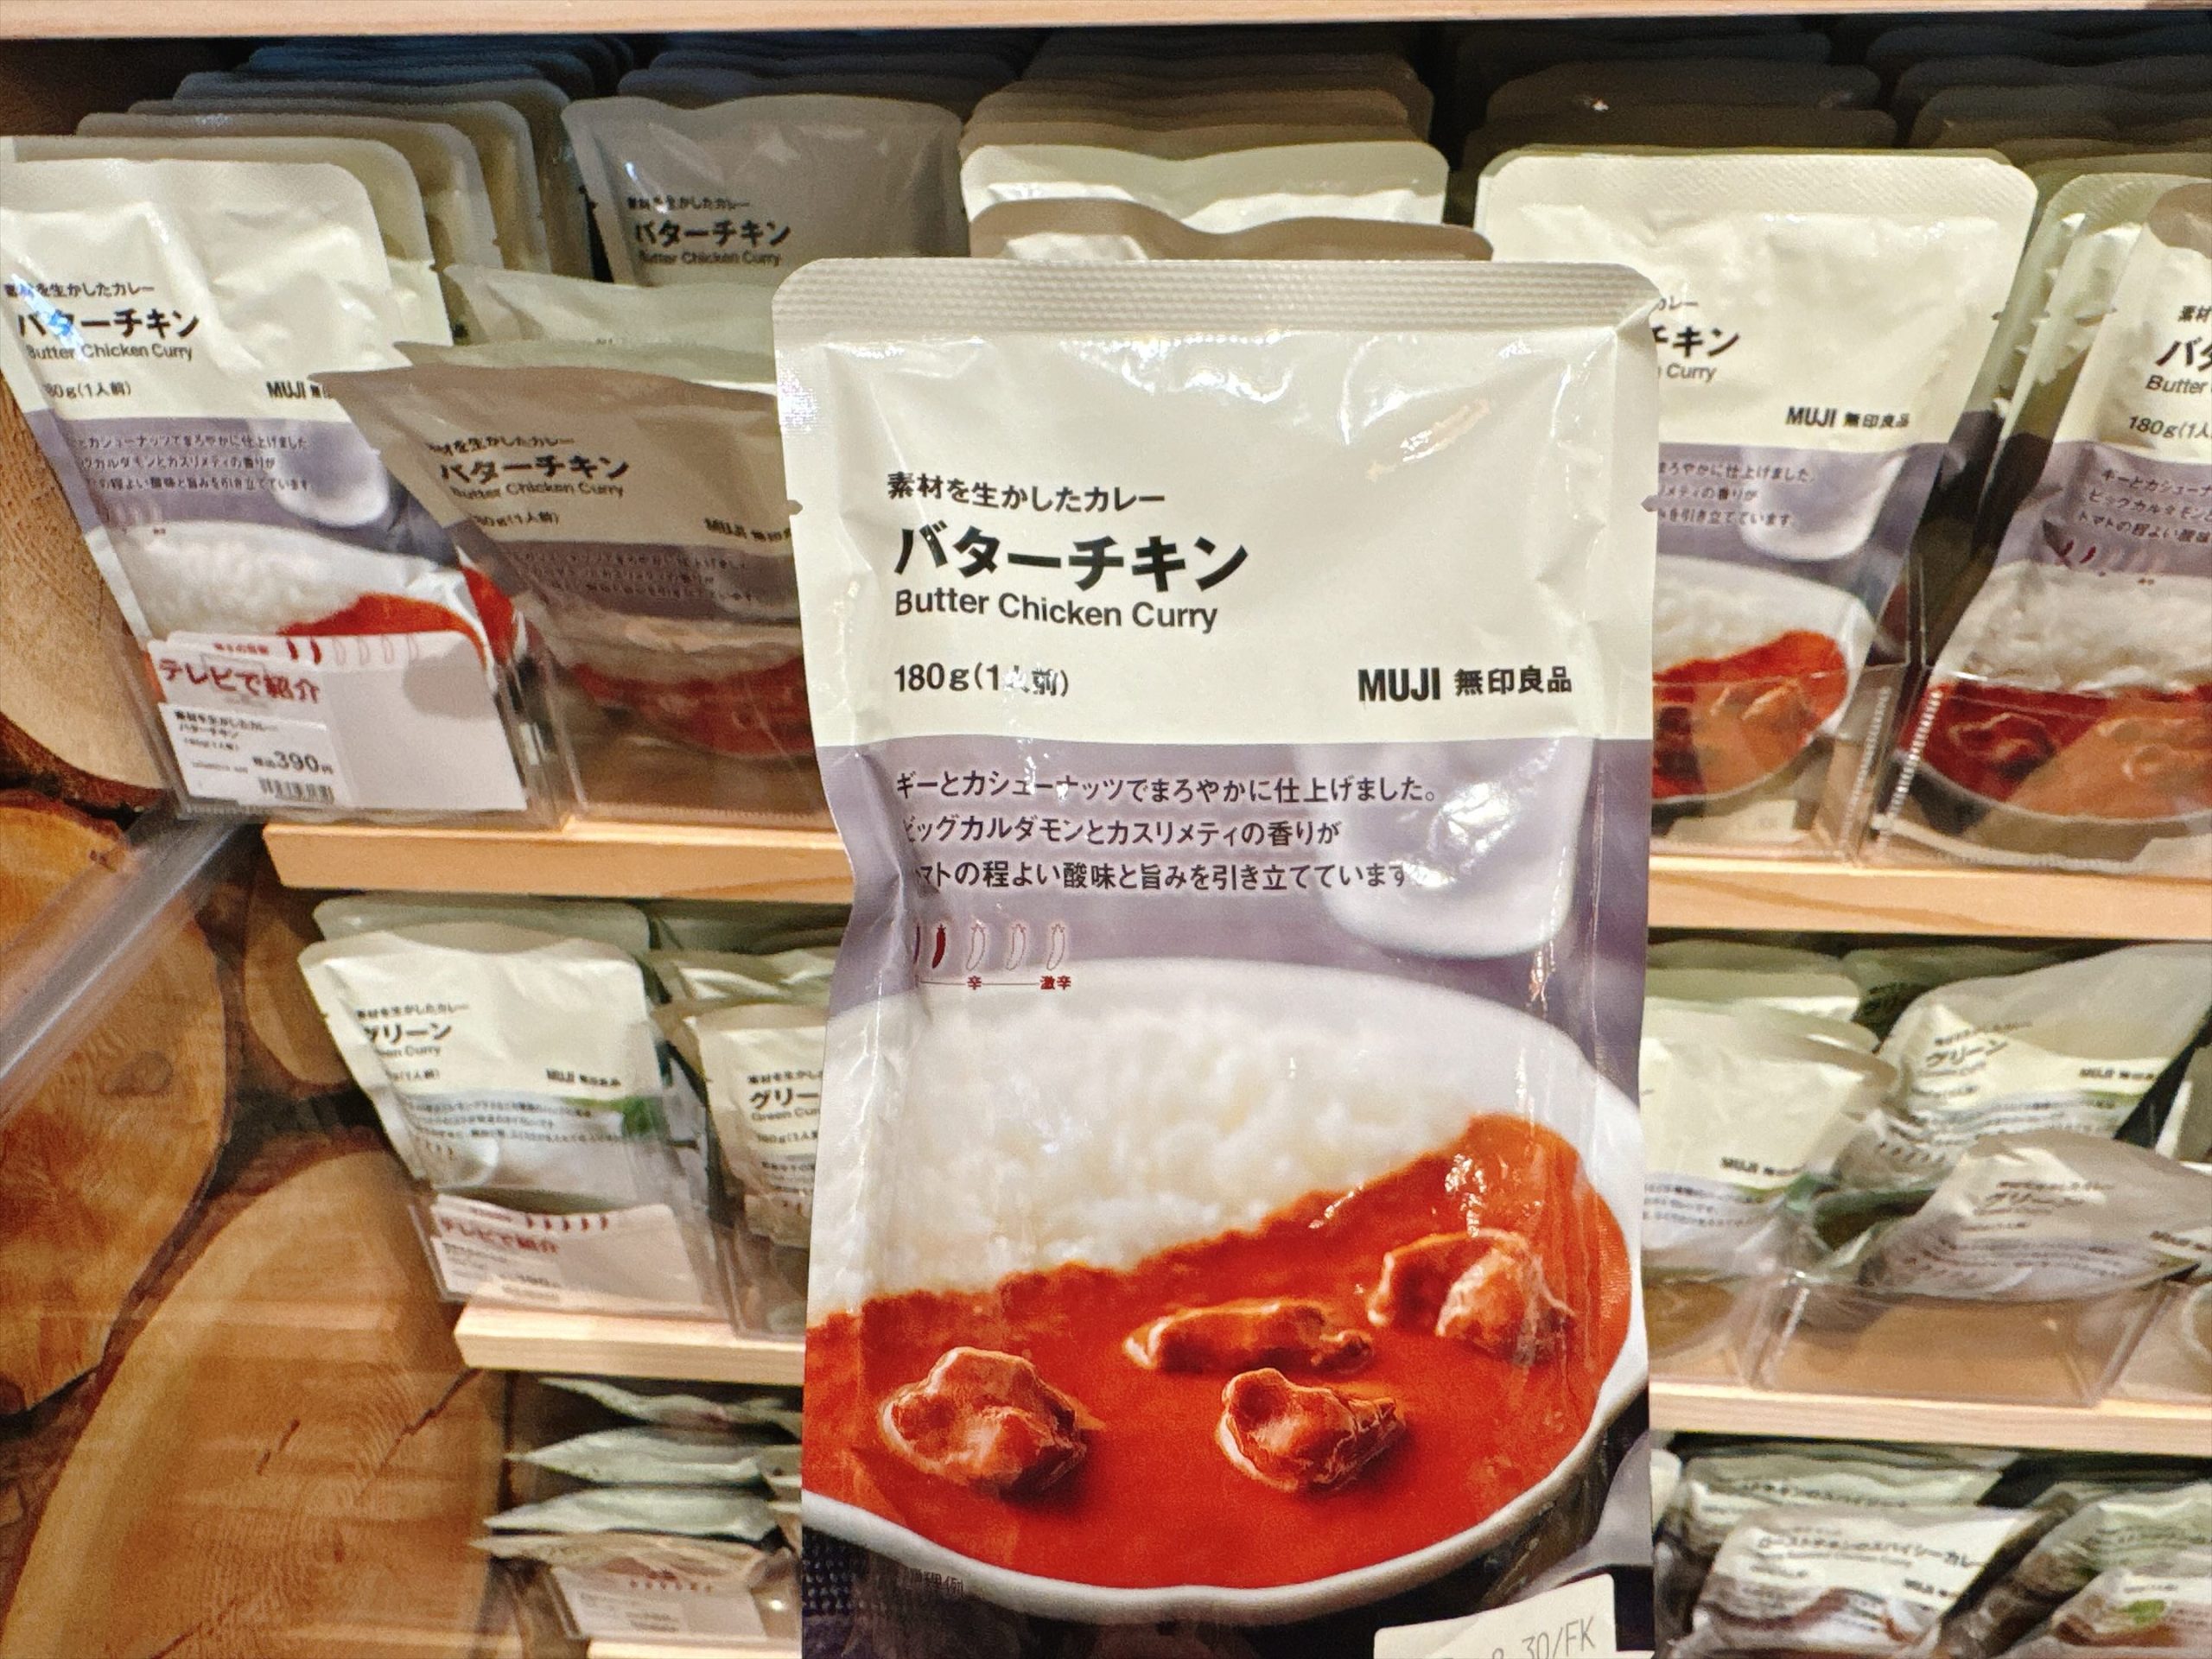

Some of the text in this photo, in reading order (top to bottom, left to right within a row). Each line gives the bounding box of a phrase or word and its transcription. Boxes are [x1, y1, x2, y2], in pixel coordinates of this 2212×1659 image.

[635, 219, 791, 248] バターチキン
[81, 343, 149, 359] Chicken
[152, 346, 193, 362] Curry
[1667, 362, 1718, 383] Curry
[2146, 374, 2209, 394] Butter
[266, 380, 306, 399] MUJI
[1785, 405, 1838, 429] MUJI
[440, 454, 630, 485] バターチキン
[887, 471, 1166, 513] 素材を生かしたカレー
[893, 519, 1249, 593] バターチキン
[894, 587, 1218, 634] Butter Chicken Curry
[159, 658, 321, 703] テレビで紹介
[1357, 664, 1573, 702] MUJI 無印良品
[914, 861, 1406, 891] マトの程よい酸味と旨みを引き立てています
[966, 975, 1072, 991] 辛 激辛
